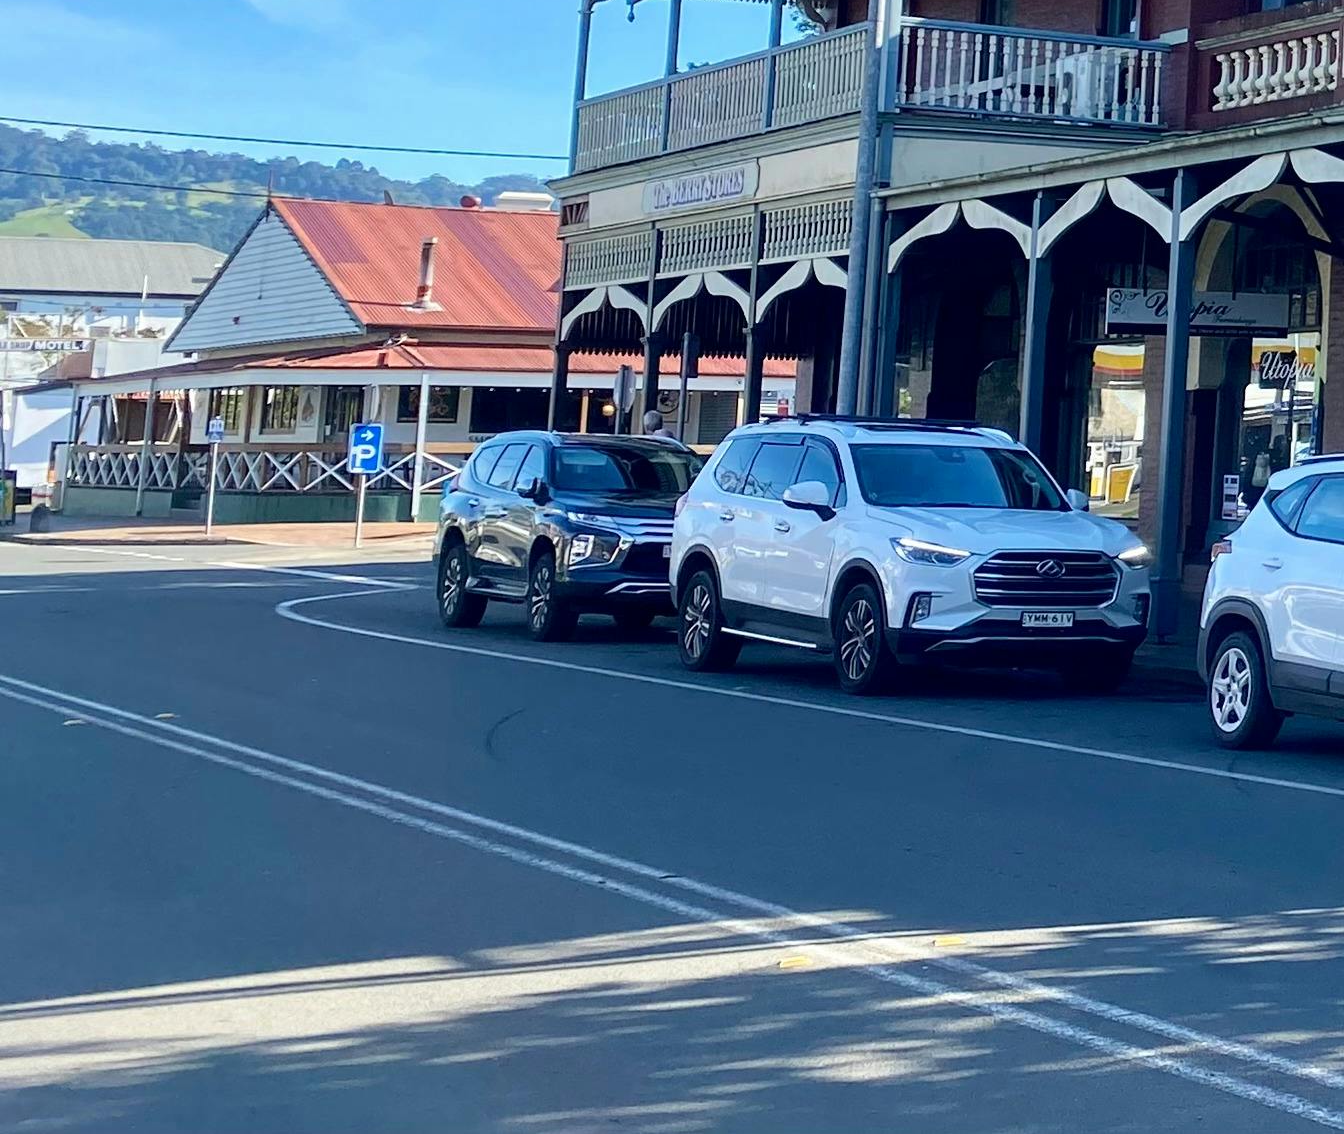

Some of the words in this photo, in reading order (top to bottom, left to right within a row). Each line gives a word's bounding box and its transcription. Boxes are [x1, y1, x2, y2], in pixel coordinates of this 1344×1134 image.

[653, 181, 671, 210] The
[671, 174, 704, 206] BERRY
[704, 168, 745, 201] STORES
[34, 340, 80, 351] MOTEL
[1260, 350, 1315, 388] Utopia
